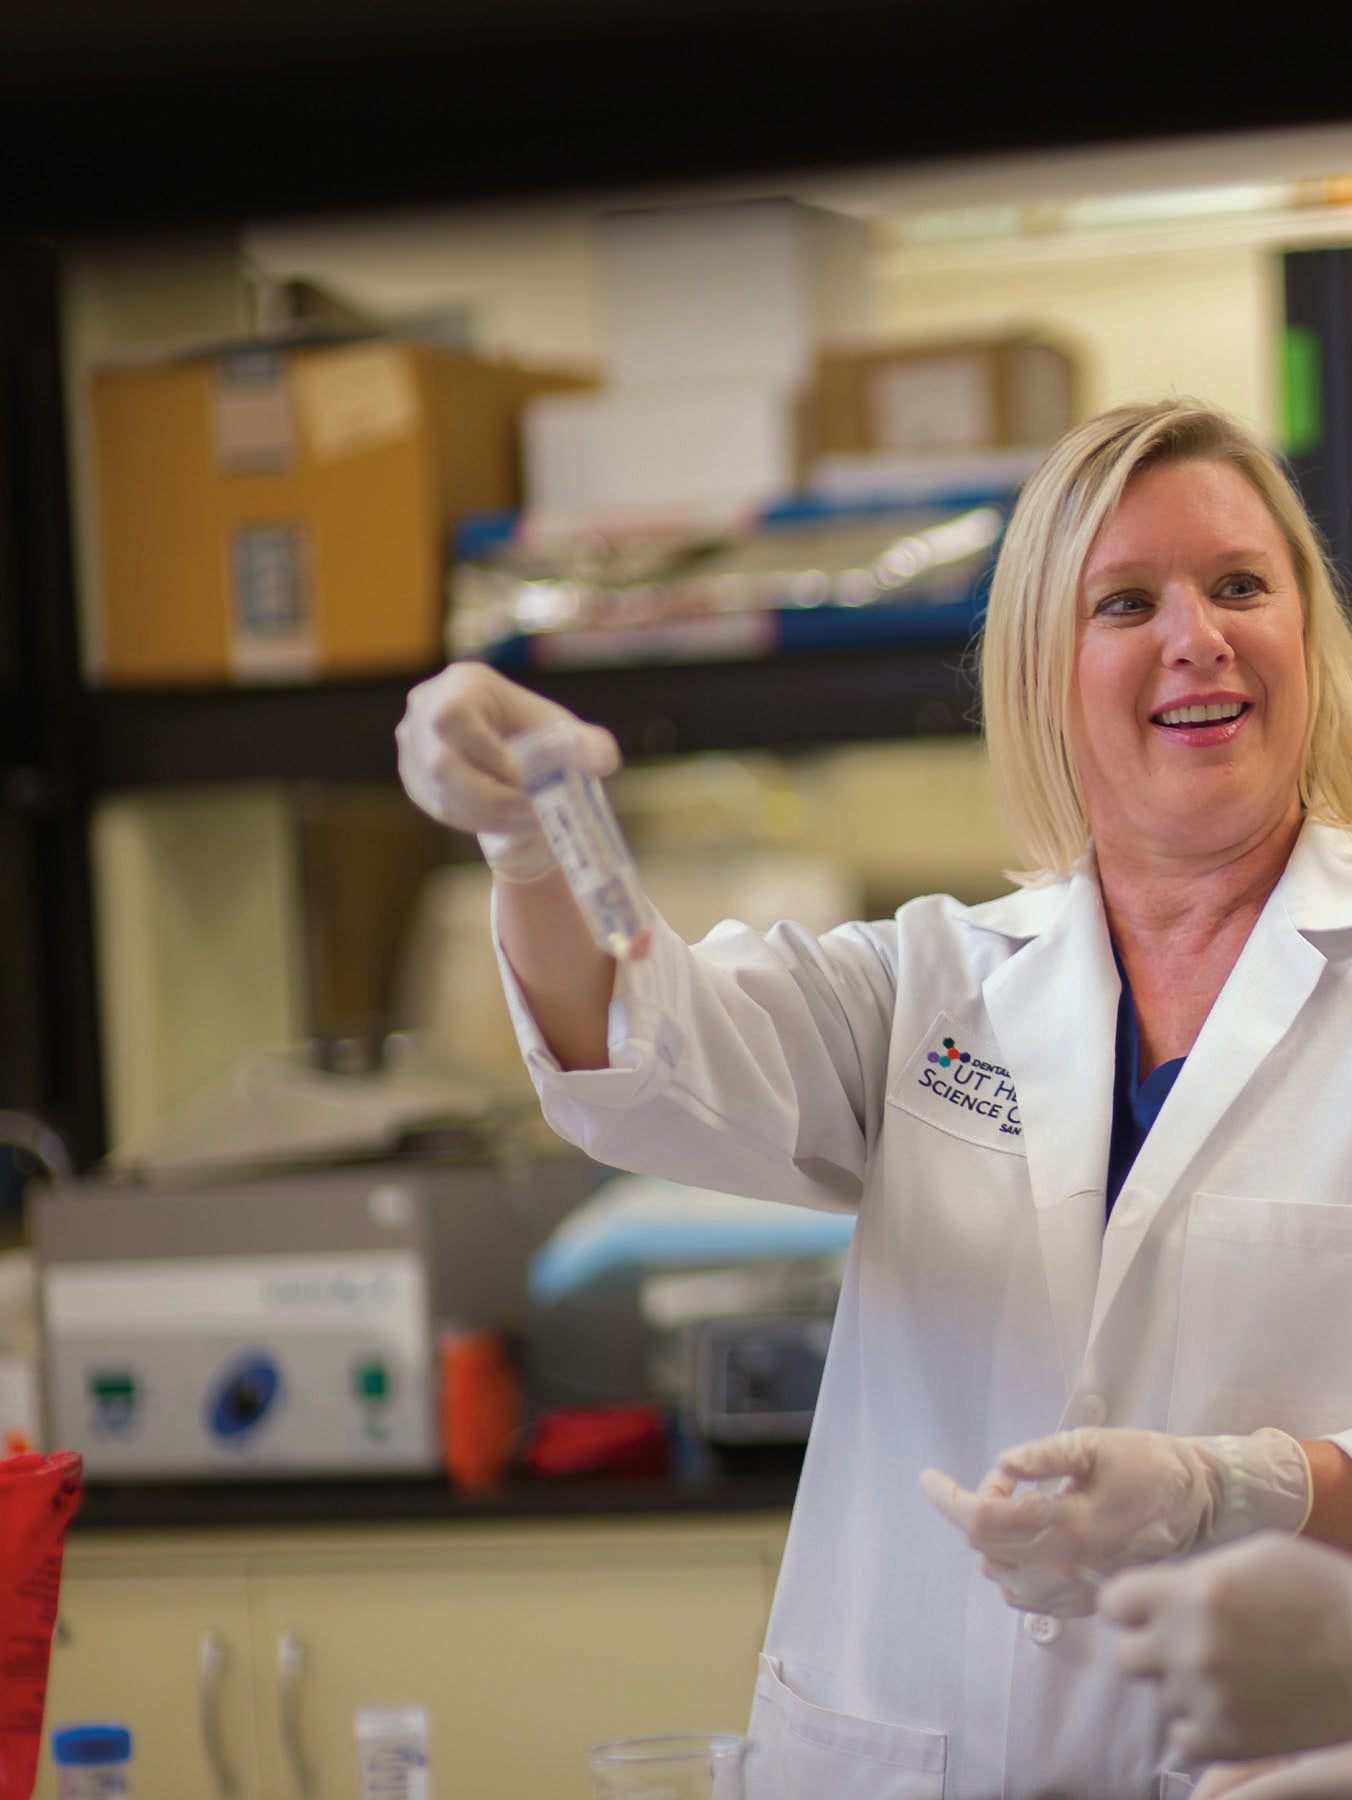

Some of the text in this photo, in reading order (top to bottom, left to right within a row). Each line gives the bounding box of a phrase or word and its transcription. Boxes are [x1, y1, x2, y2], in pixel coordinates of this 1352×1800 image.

[954, 1065, 991, 1091] UT
[918, 1068, 1003, 1118] SCIENCE
[999, 1123, 1021, 1135] SAN
